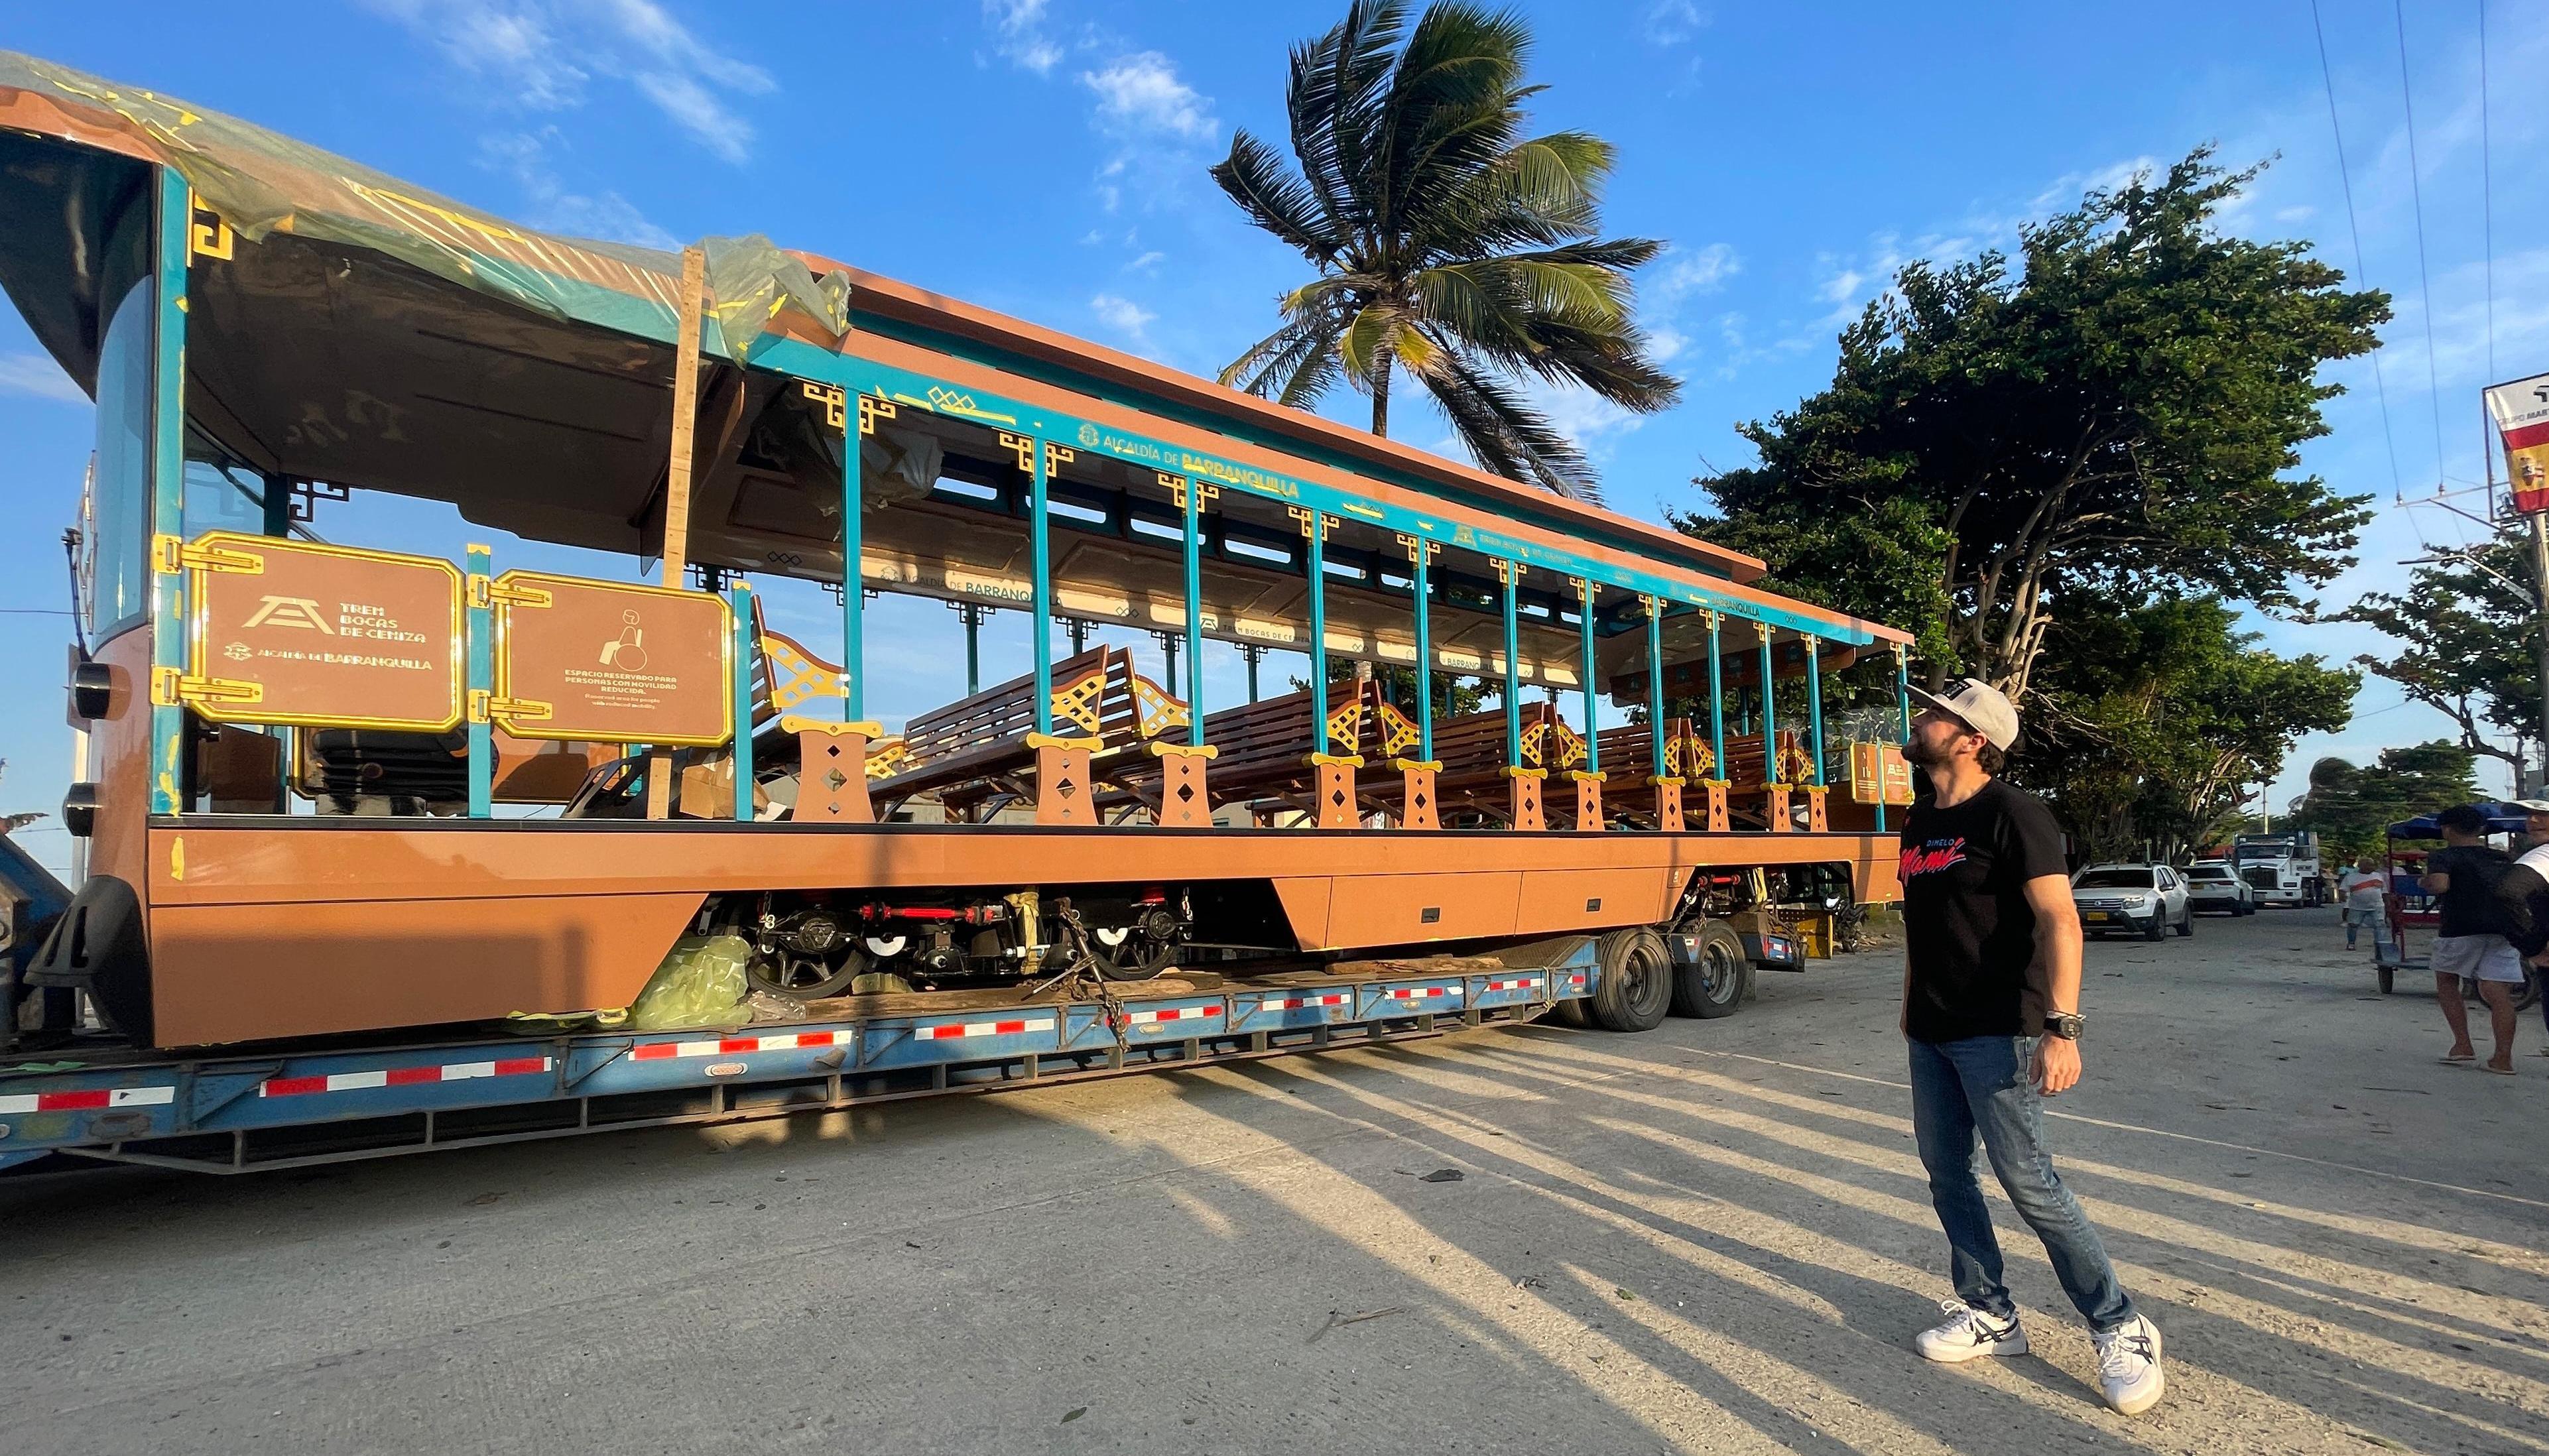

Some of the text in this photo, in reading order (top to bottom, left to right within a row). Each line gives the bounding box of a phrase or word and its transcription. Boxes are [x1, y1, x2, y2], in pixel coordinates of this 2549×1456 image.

[1103, 434, 1300, 499] ALCALDÍA DE BARRANQUILLA
[902, 574, 946, 589] ALCALDÍA
[950, 581, 962, 590] DE
[340, 615, 398, 629] BOCAS
[340, 626, 426, 643] DE CENIZA
[1245, 628, 1270, 637] BOCAS
[324, 652, 432, 670] BARRANQUILLA
[565, 677, 611, 686] PERSONAS
[631, 682, 677, 690] MOVILIDAD
[604, 672, 654, 682] RESERVADO
[601, 686, 647, 695] REDUCIDA.
